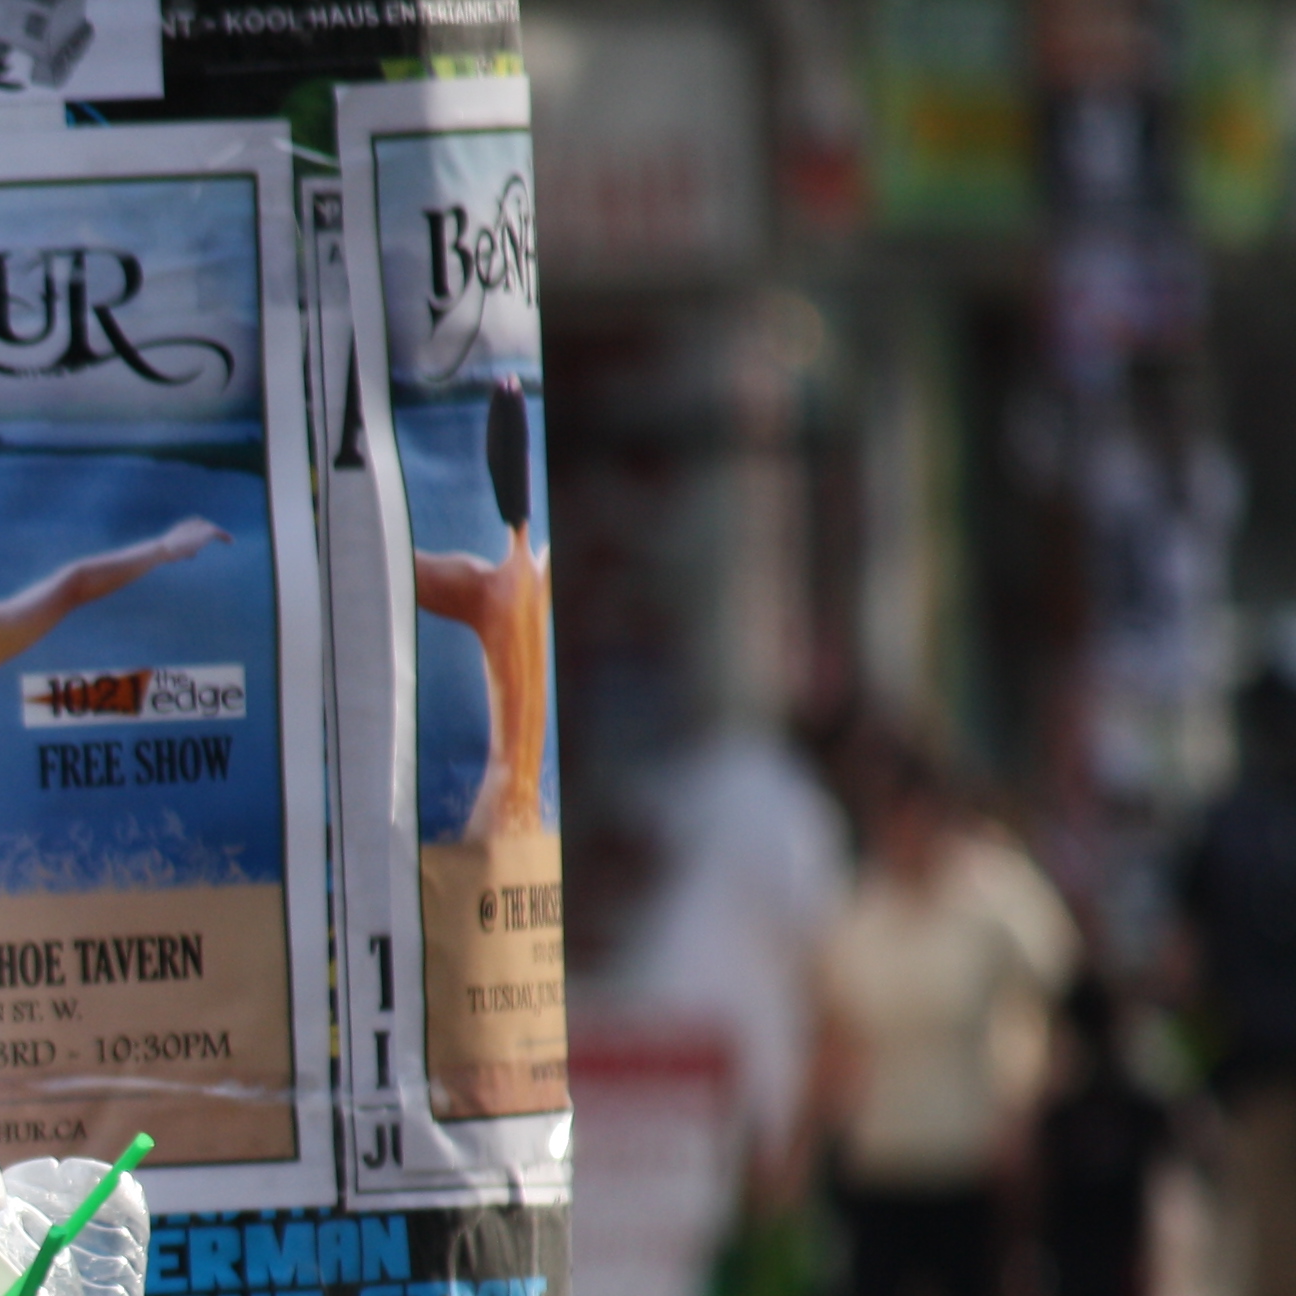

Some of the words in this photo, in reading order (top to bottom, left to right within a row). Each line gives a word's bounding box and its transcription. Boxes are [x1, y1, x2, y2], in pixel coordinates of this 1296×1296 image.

[150, 680, 244, 717] edge
[38, 740, 126, 791] FREE
[134, 735, 233, 786] SHOW
[74, 932, 204, 985] TAVERN
[95, 1031, 232, 1064] 10:30PM
